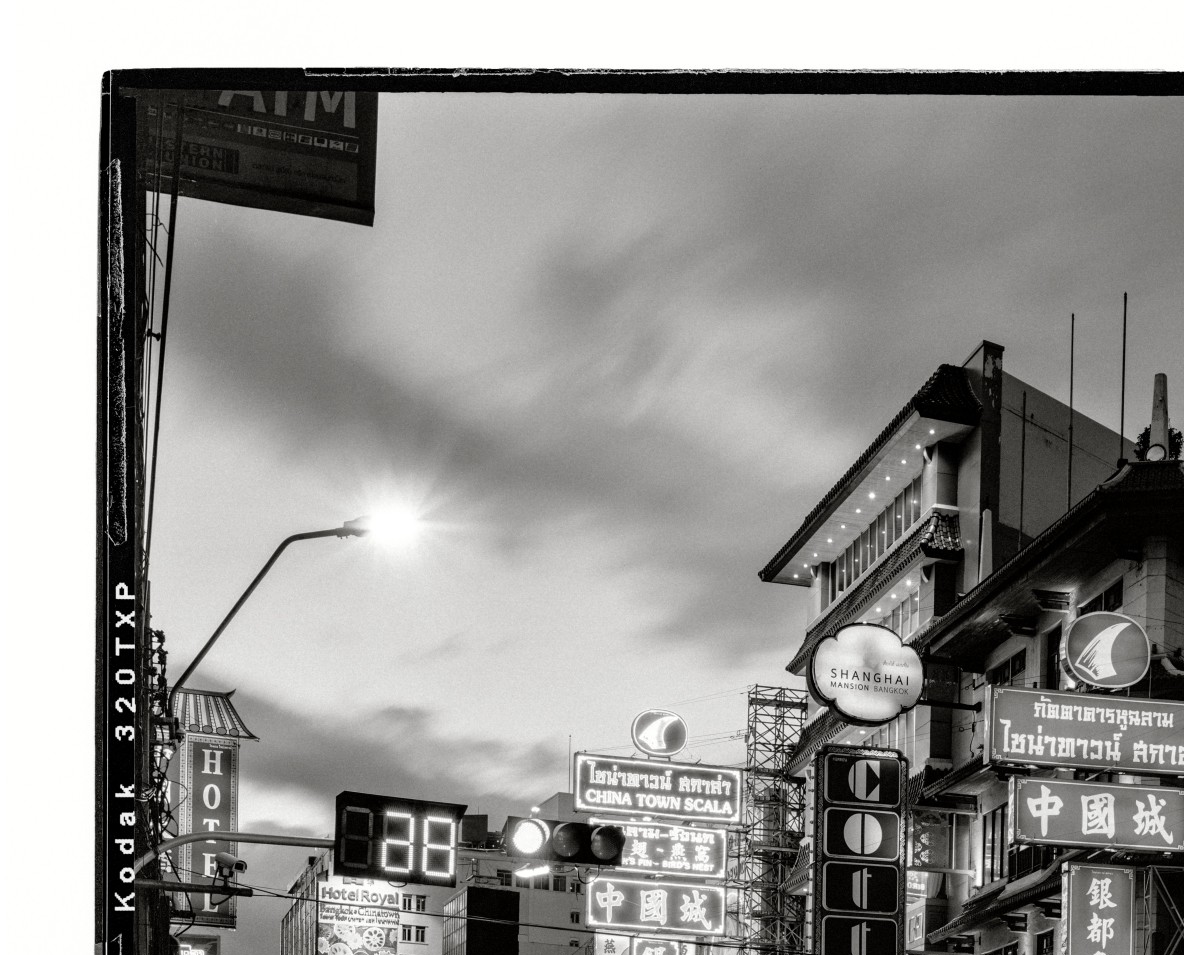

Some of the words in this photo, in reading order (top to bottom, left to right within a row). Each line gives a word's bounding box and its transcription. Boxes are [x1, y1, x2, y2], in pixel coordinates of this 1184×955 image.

[830, 668, 909, 686] SHANGHAI
[830, 681, 870, 691] MANSION
[873, 685, 909, 695] BANGKOK
[585, 788, 632, 807] CHINA
[635, 793, 681, 811] TOWN
[683, 797, 733, 815] SCALA
[1026, 784, 1174, 845] 中國城
[200, 749, 224, 913] HOTEL
[321, 886, 359, 902] Hotel
[361, 889, 400, 906] Royal
[595, 882, 712, 931] 中國城
